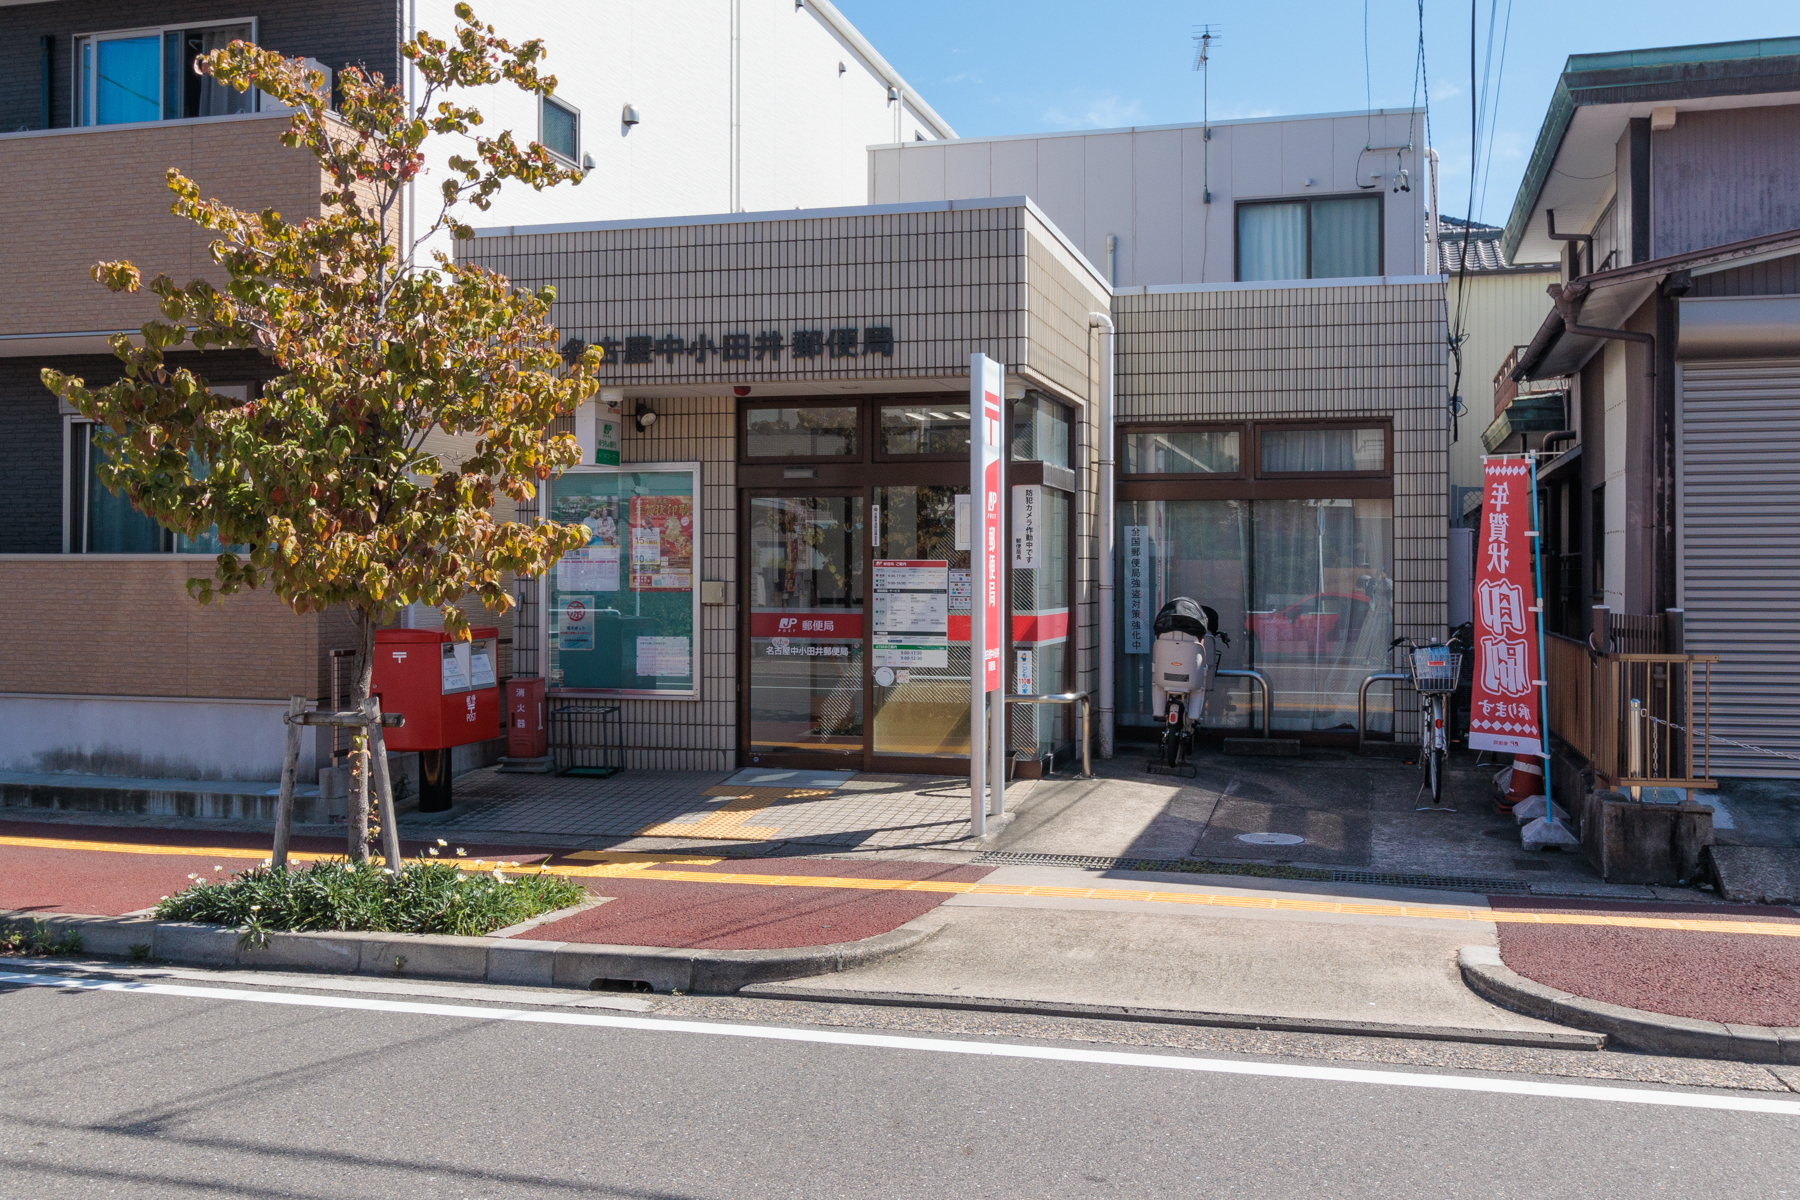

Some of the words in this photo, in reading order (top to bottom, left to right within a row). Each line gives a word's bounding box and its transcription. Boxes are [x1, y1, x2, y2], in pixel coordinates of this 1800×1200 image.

[561, 326, 895, 366] 名古屋中小田井郵便局
[1025, 489, 1034, 563] 防犯カメラ作動中です
[988, 526, 996, 608] 郵便局
[1131, 527, 1141, 650] 全国郵便局強盗対策強化中
[779, 617, 797, 629] JP
[801, 620, 834, 631] 郵便局
[766, 646, 849, 656] 名古屋中小田井郵便局
[466, 712, 477, 722] POST
[516, 688, 526, 729] 消火器
